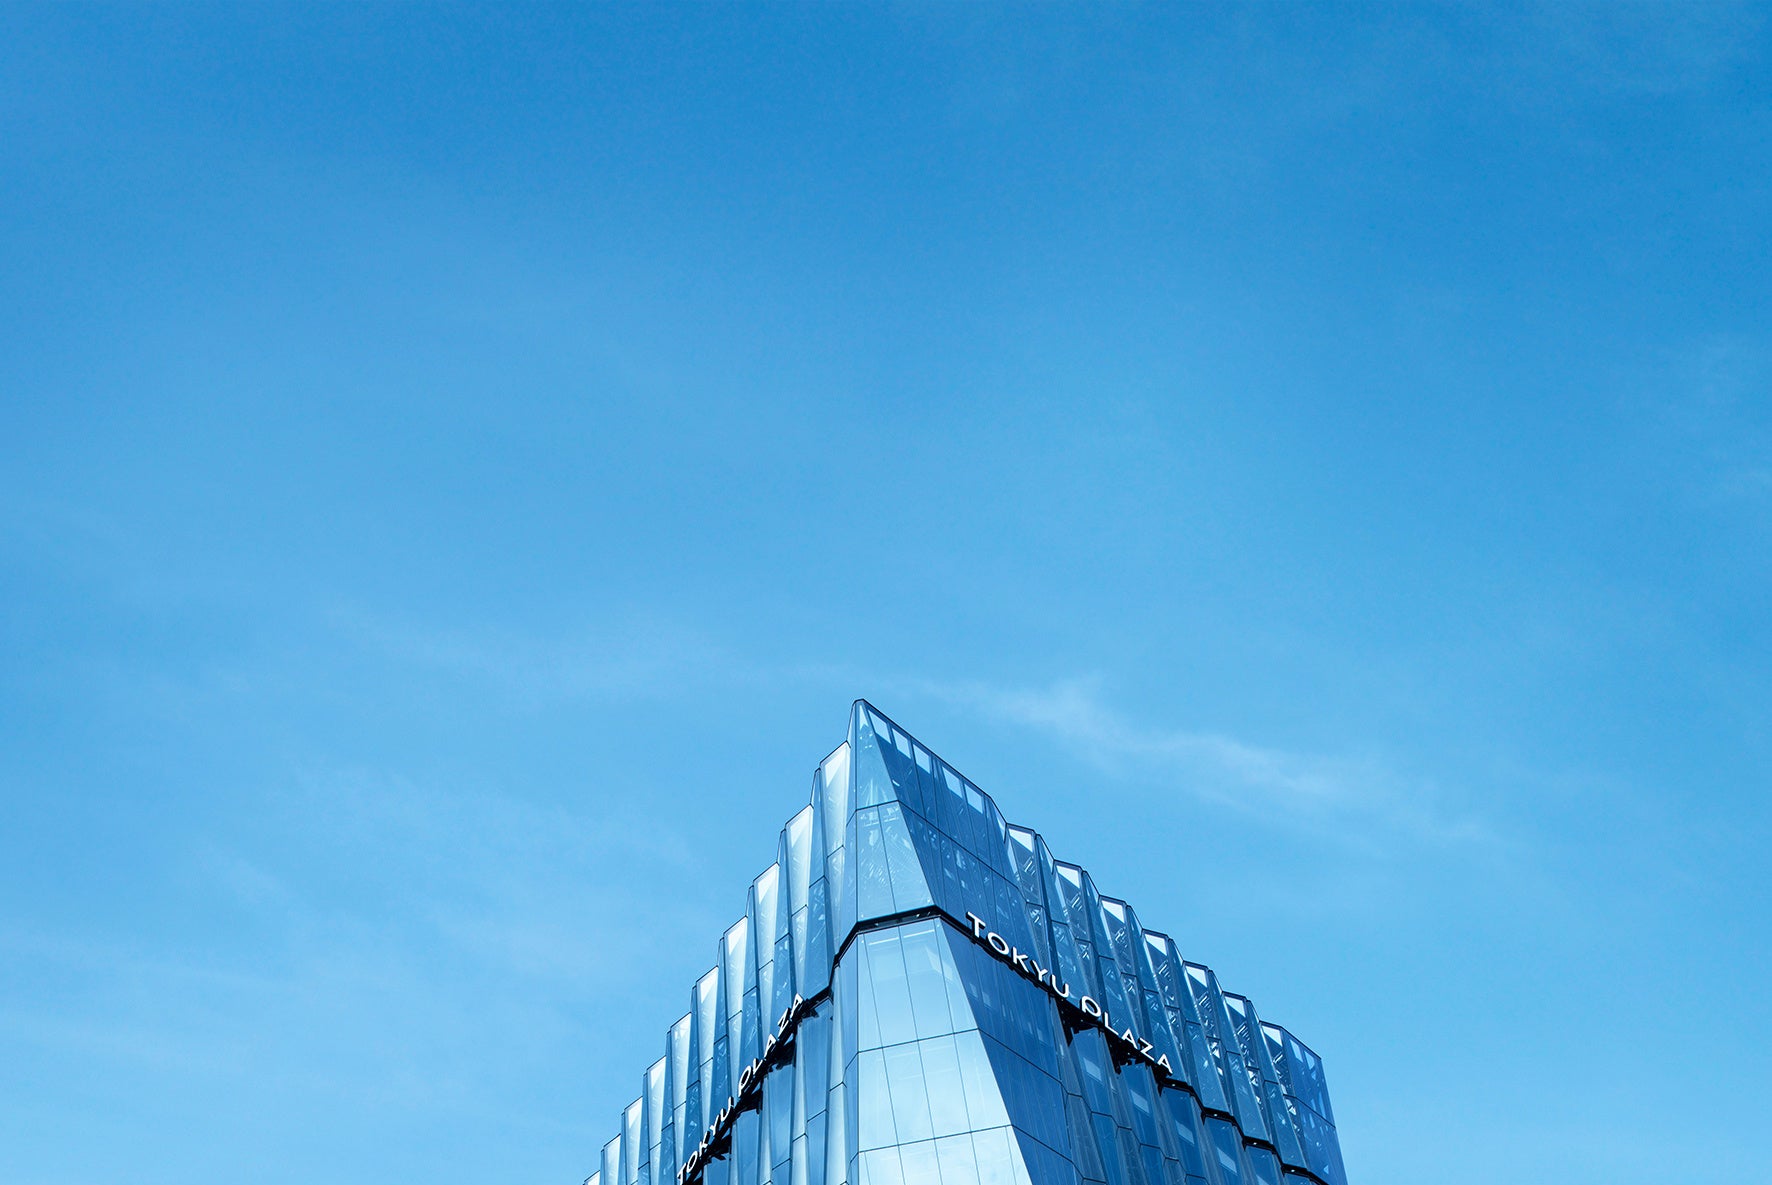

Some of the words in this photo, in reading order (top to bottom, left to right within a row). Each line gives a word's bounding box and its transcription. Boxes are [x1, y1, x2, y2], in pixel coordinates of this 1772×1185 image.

[738, 993, 804, 1098] PLAZA
[966, 911, 1070, 998] TOKYU
[1080, 996, 1173, 1074] PLAZA
